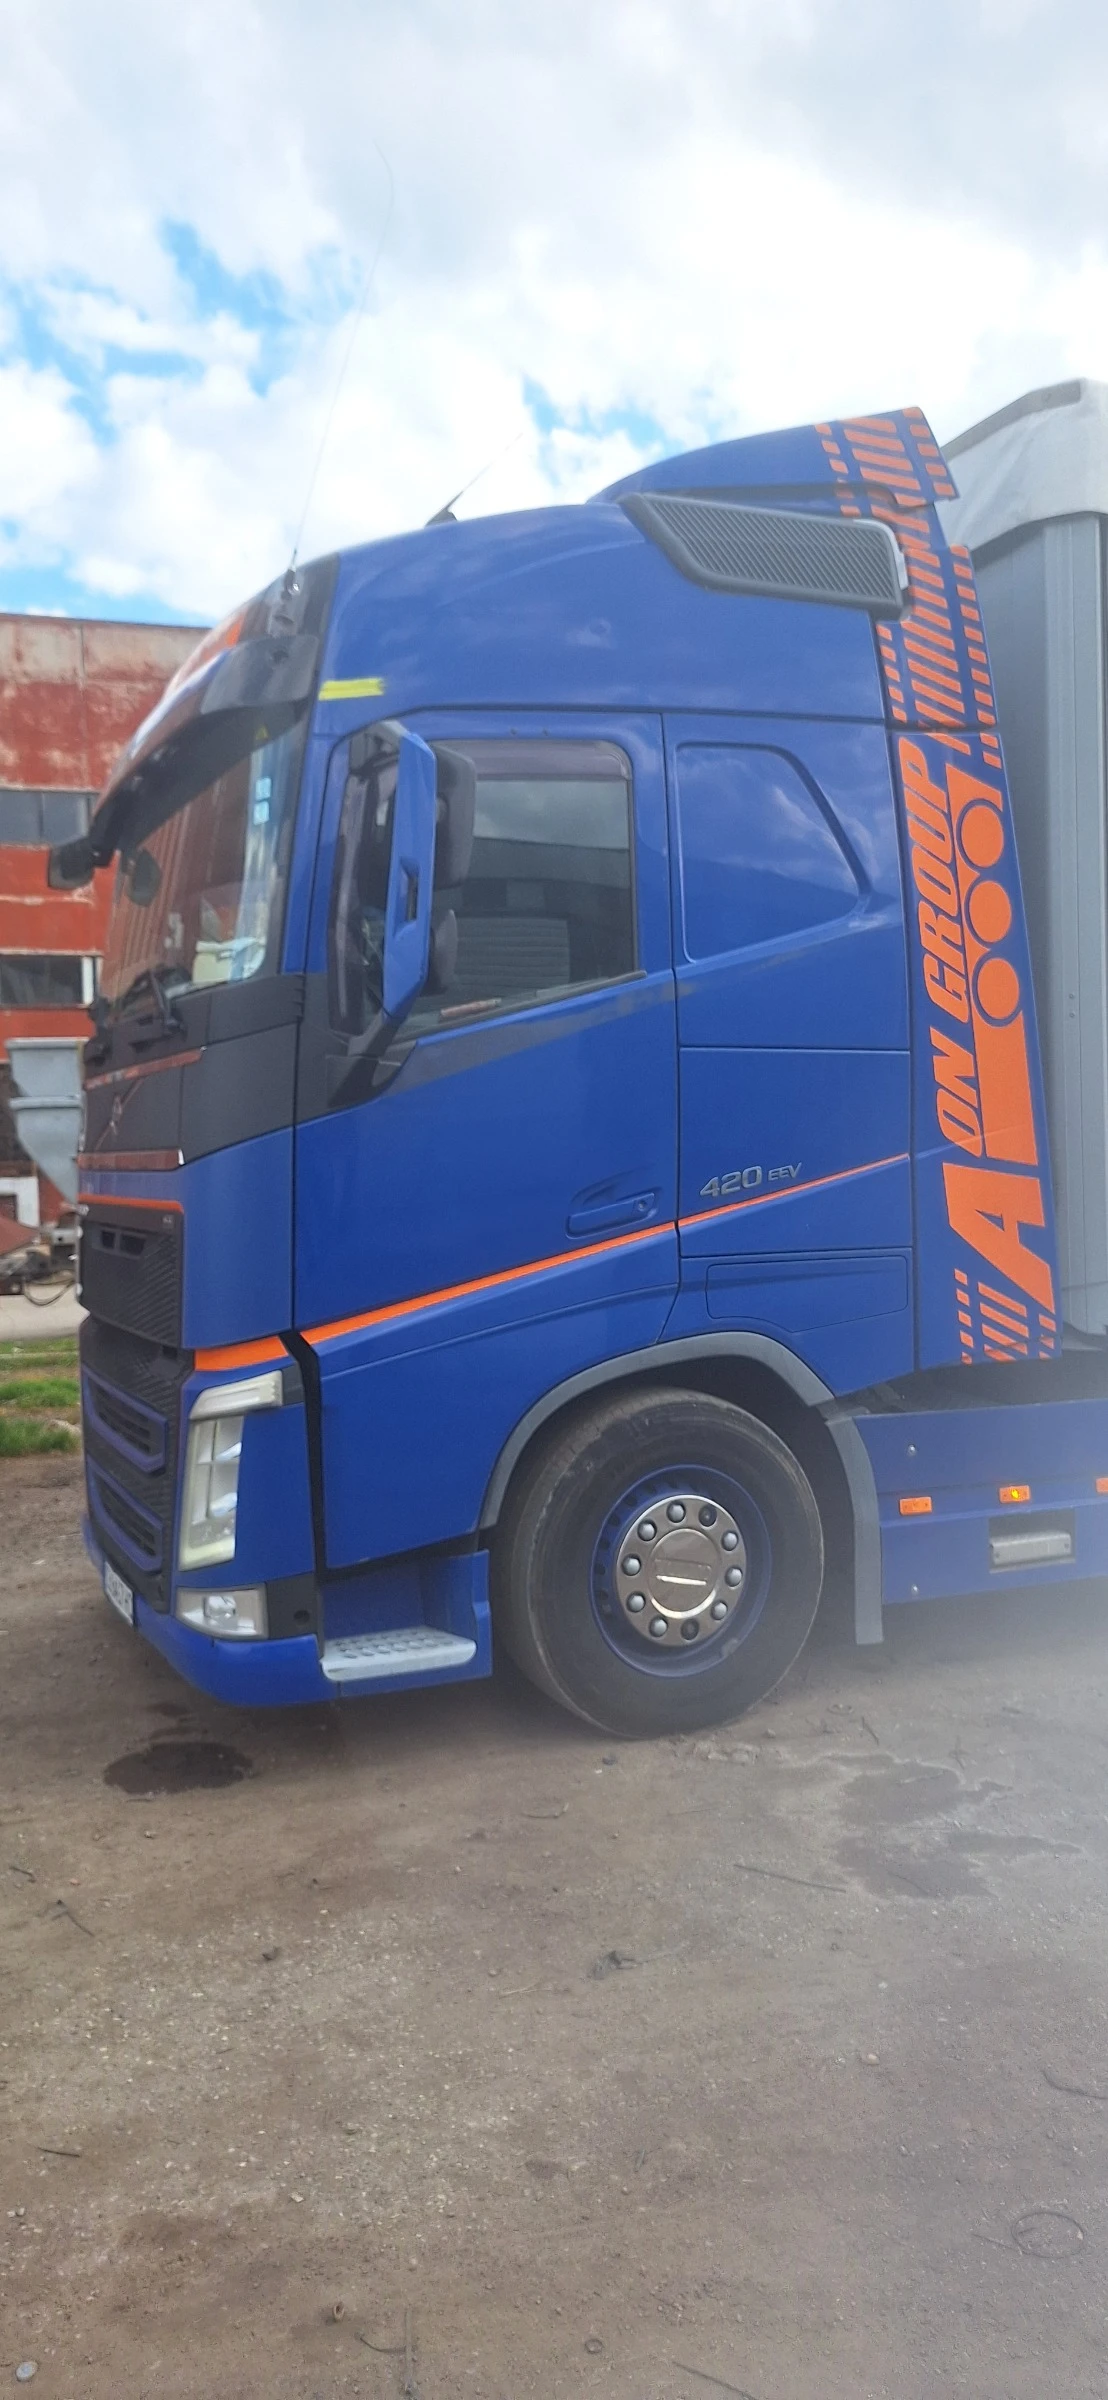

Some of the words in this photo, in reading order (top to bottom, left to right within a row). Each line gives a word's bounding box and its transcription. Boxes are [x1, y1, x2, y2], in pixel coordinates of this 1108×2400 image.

[899, 736, 969, 1024] GROUP
[700, 1165, 763, 1197] 420
[768, 1162, 802, 1181] EEV
